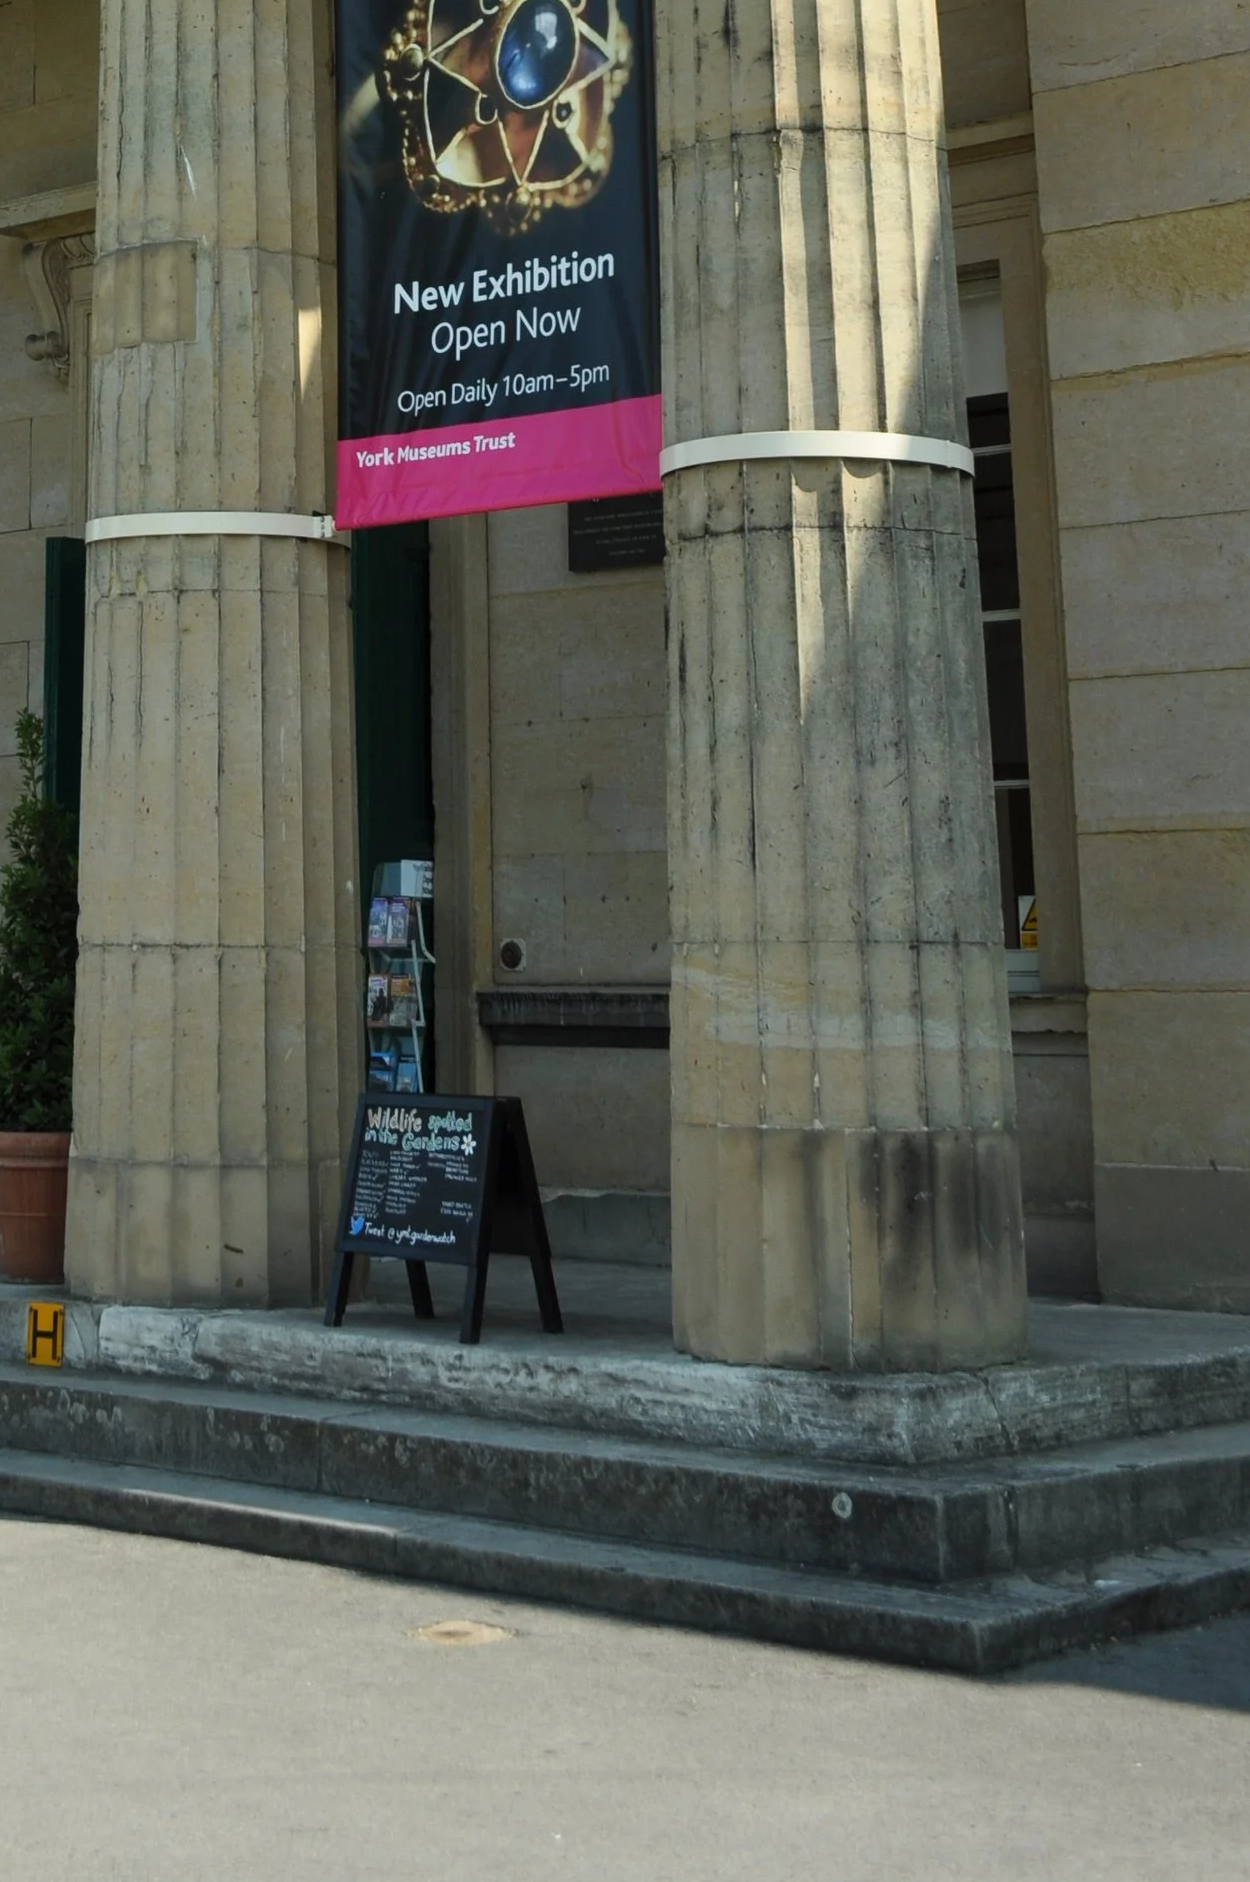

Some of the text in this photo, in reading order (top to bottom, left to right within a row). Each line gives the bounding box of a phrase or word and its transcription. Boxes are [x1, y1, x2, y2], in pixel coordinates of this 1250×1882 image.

[394, 251, 615, 314] New Exhibition
[431, 306, 581, 360] Open Now
[398, 388, 446, 416] Open
[452, 377, 498, 407] Daily
[356, 432, 516, 468] York Museums Trust
[368, 1106, 472, 1133] Wildlife spotted
[364, 1127, 460, 1151] in the Gardens
[365, 1222, 385, 1237] Tweet
[32, 1309, 58, 1360] H
